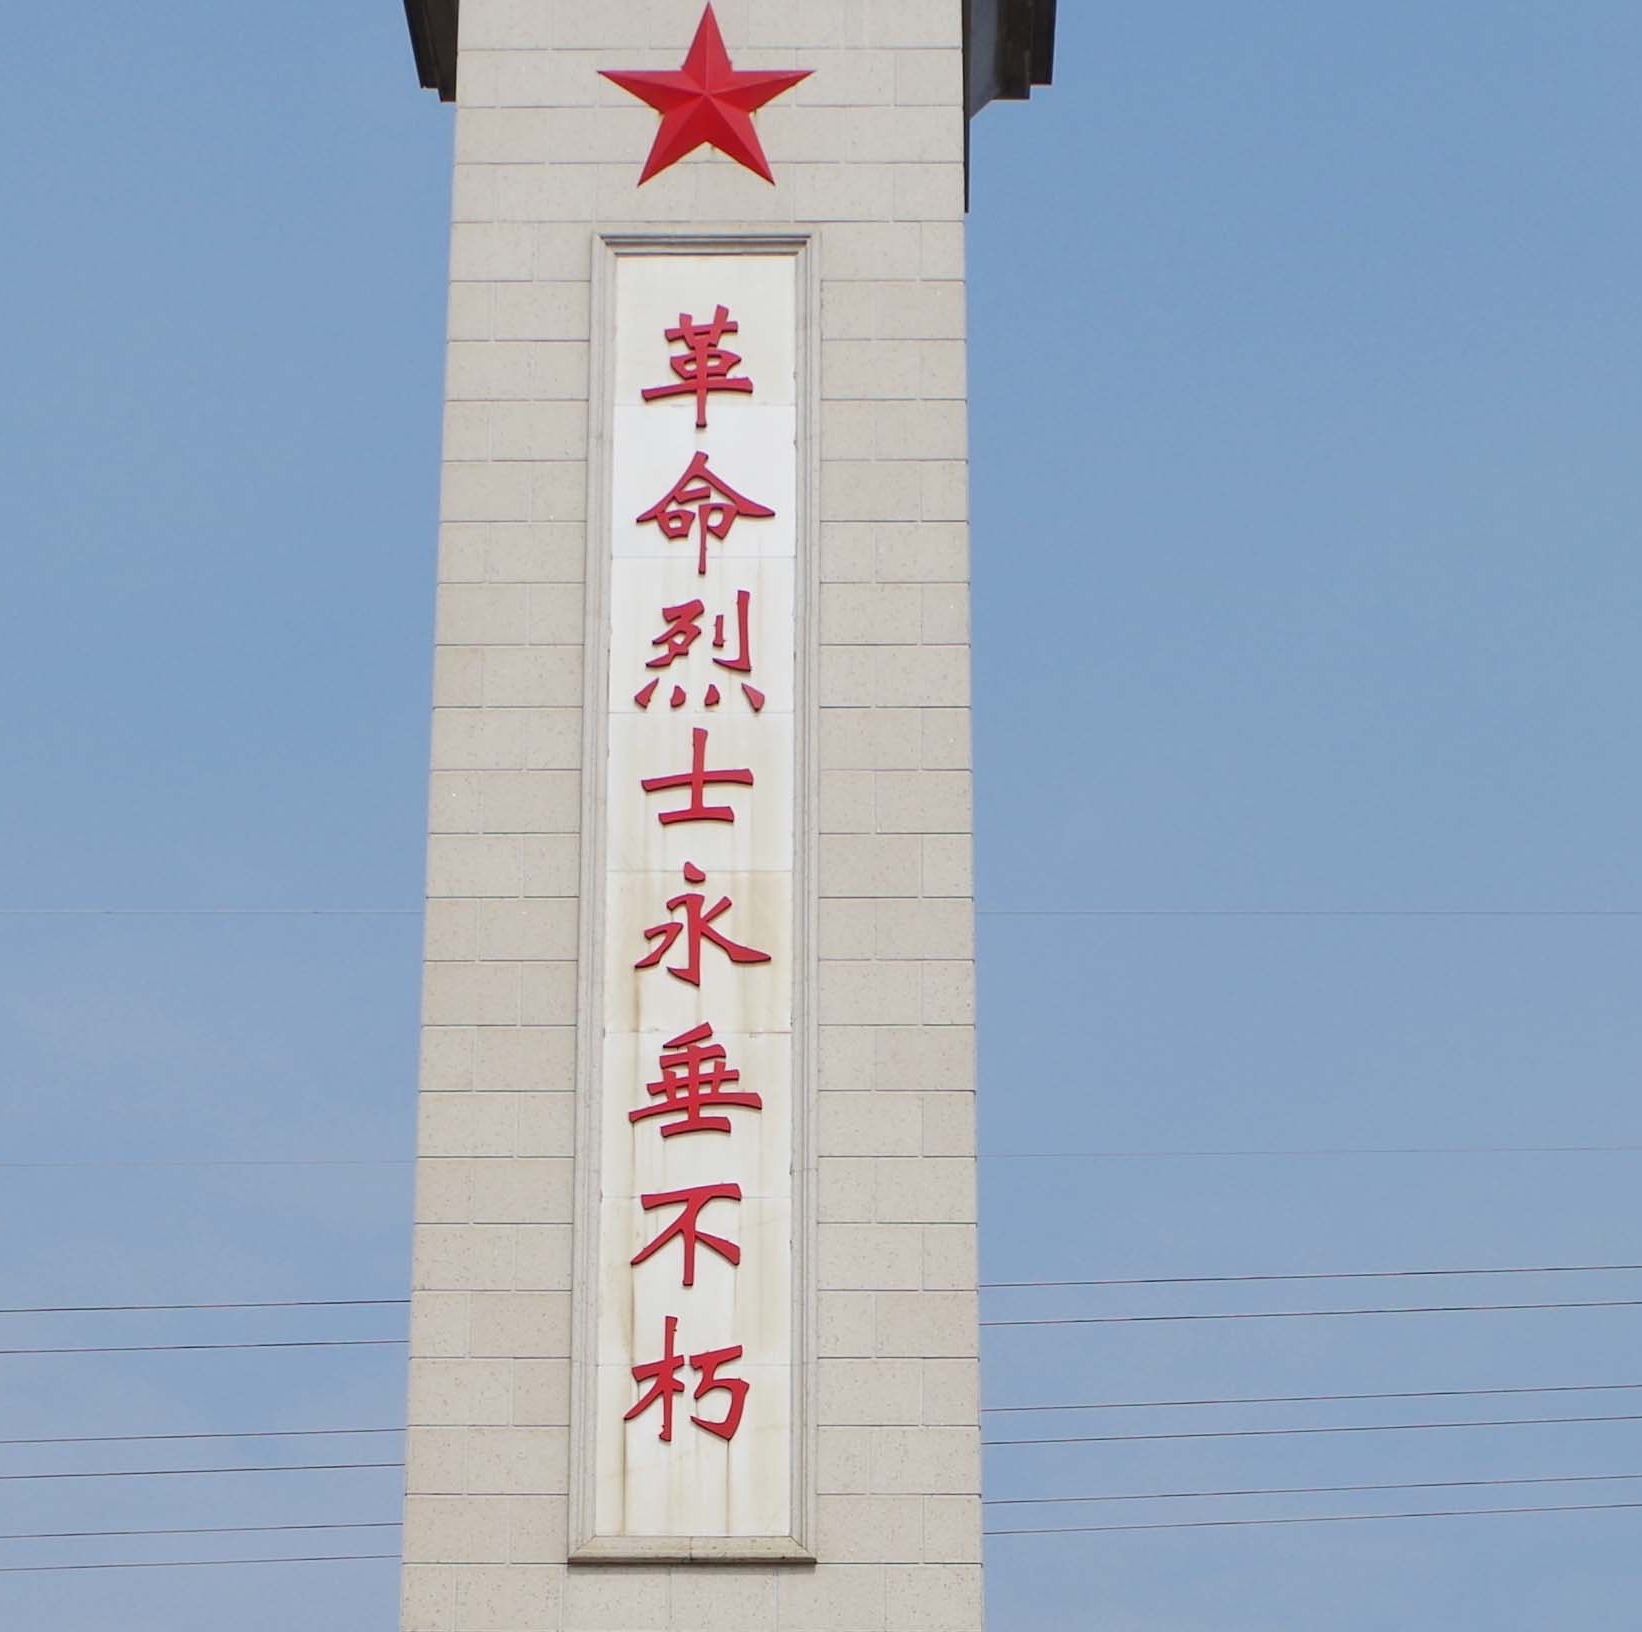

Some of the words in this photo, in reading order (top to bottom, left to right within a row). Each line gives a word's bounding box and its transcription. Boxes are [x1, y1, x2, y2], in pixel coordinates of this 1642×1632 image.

[624, 304, 775, 1441] 革命烈士永垂不朽
